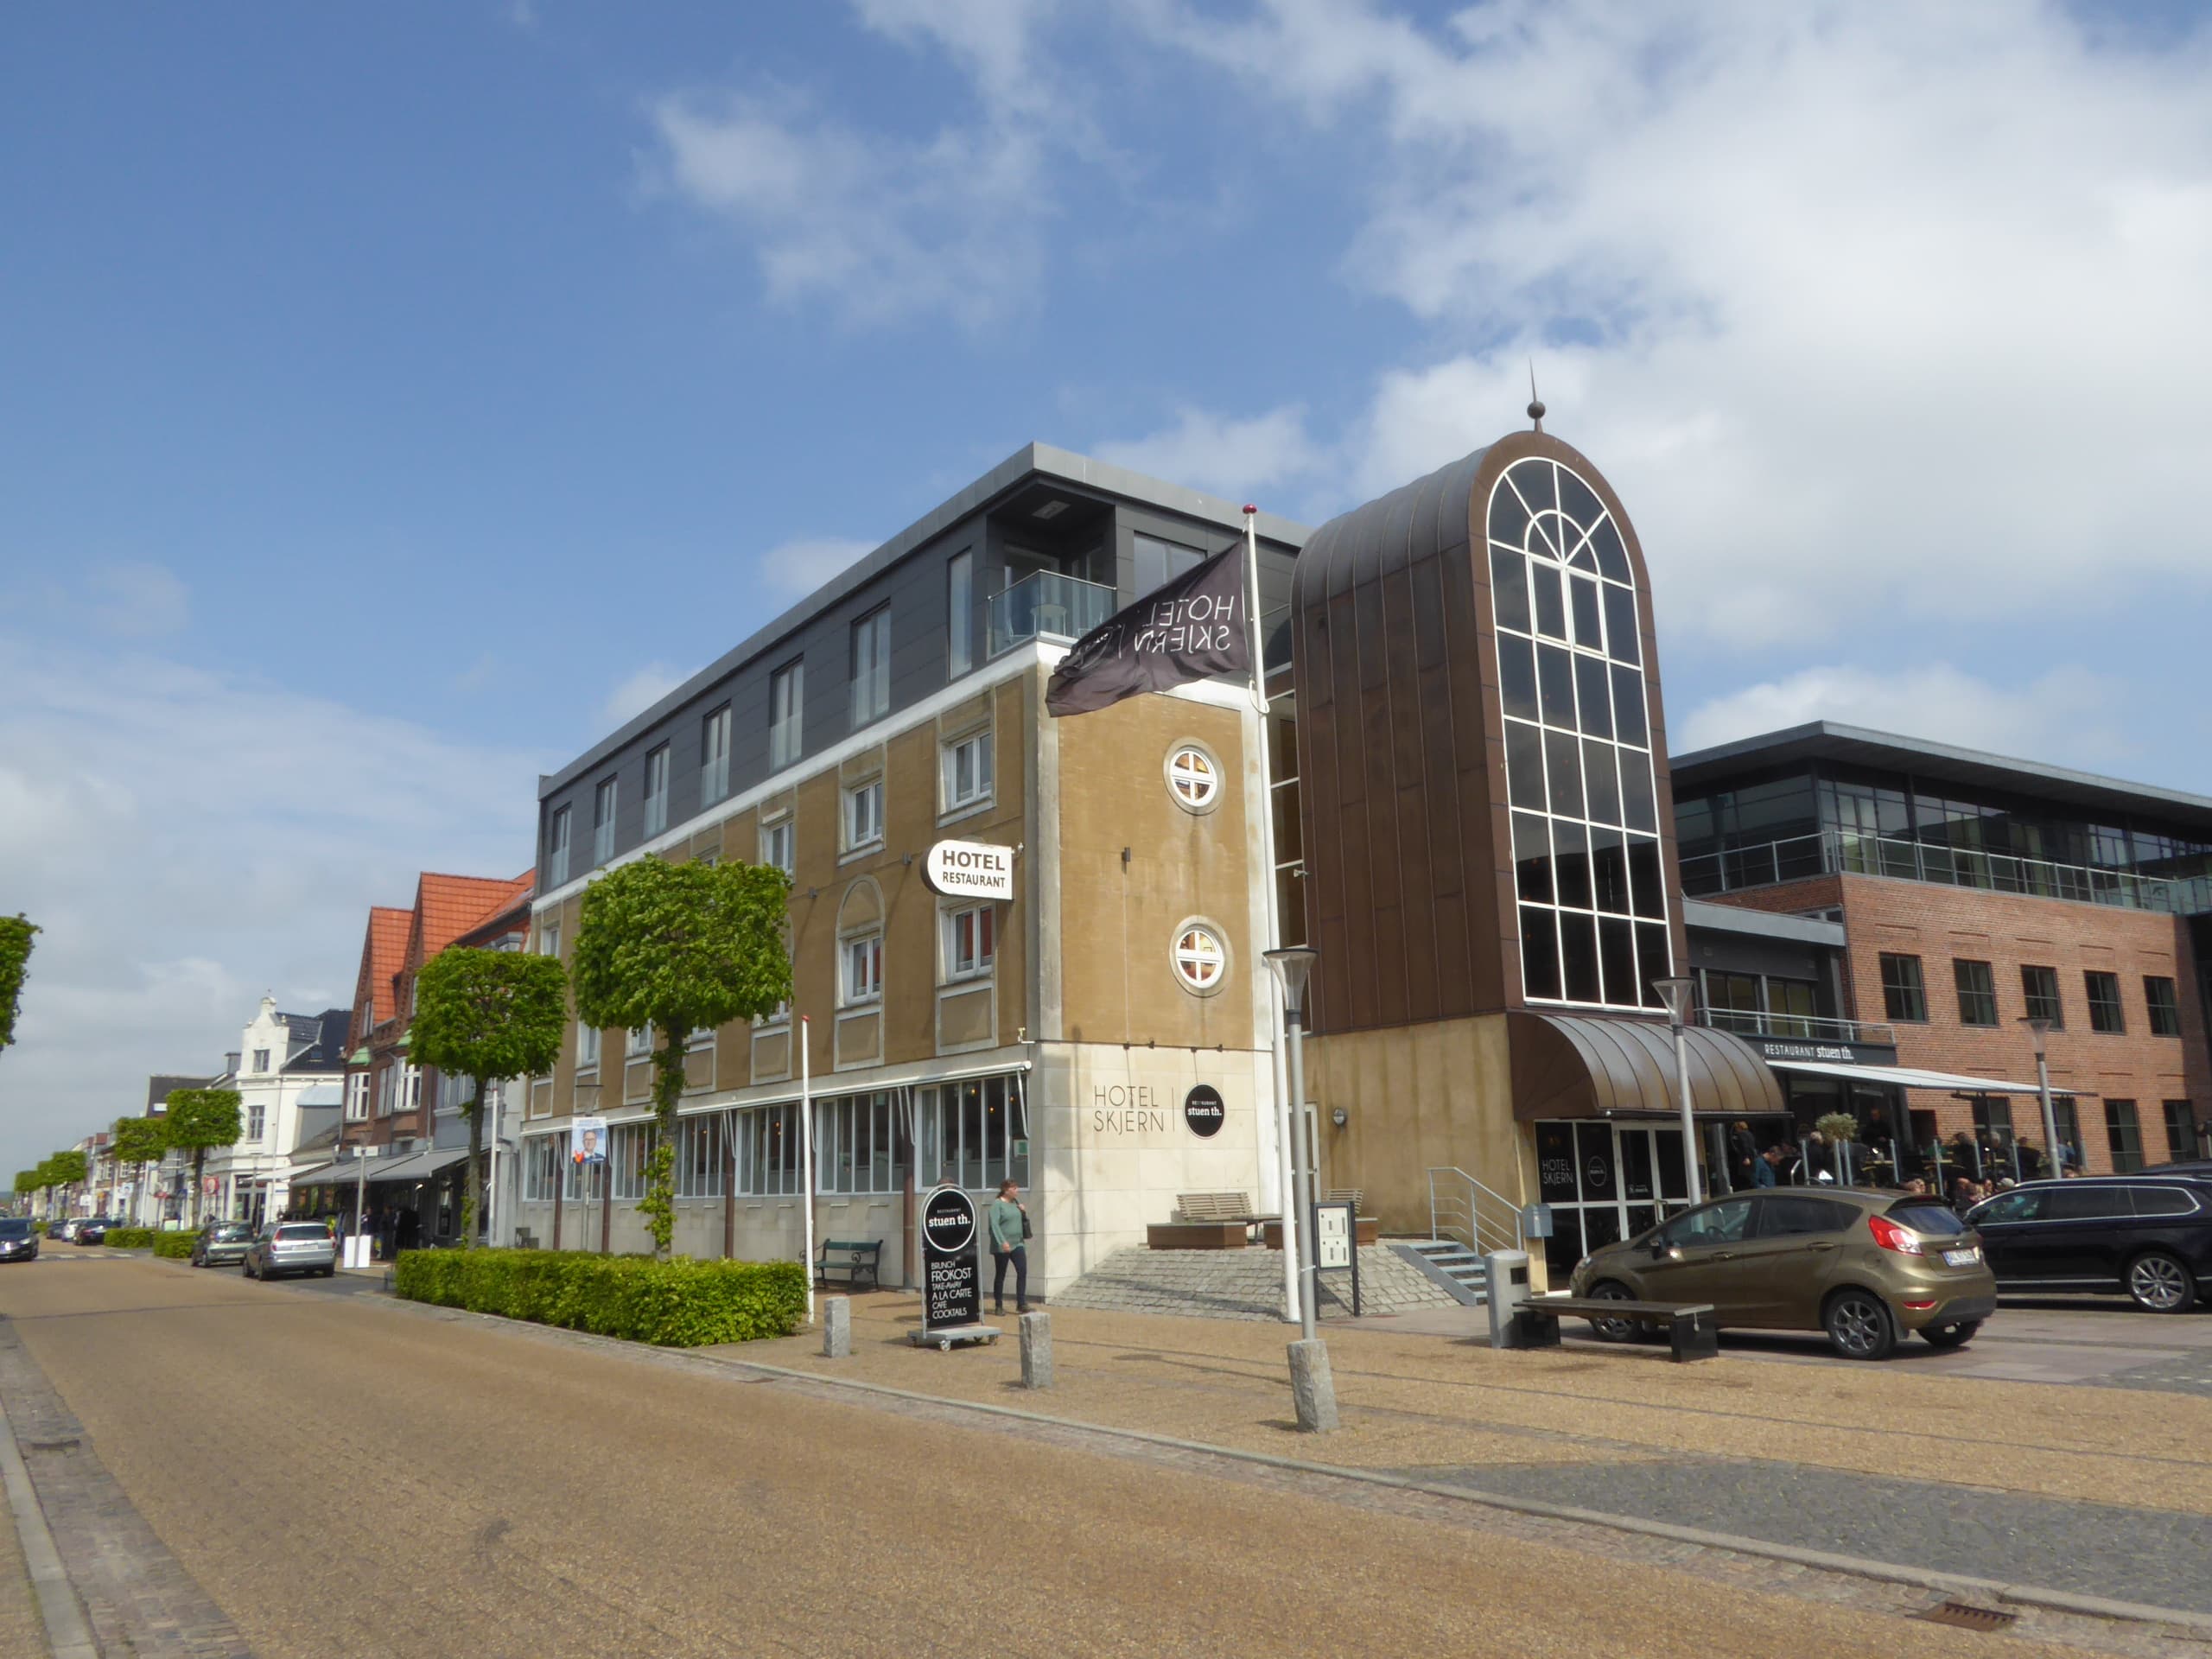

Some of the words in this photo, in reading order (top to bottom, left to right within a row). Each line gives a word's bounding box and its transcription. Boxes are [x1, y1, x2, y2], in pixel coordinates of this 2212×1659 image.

[943, 850, 1005, 871] HOTEL
[942, 871, 1005, 888] RESTAURANT
[1764, 1044, 1815, 1057] RESTAURANT
[1816, 1046, 1841, 1059] stuen
[1841, 1046, 1854, 1059] th.
[1094, 1085, 1159, 1108] HOTEL
[1187, 1107, 1210, 1116] stuen
[1211, 1106, 1223, 1116] th.
[1093, 1110, 1165, 1135] SKJERN
[1541, 1159, 1571, 1172] HOTEL
[1542, 1171, 1573, 1185] SKJERN
[929, 1217, 956, 1227] stuen
[957, 1213, 971, 1225] th.
[931, 1260, 956, 1270] BRUNCH
[931, 1268, 971, 1281] FROKOST
[938, 1290, 949, 1300] LA
[950, 1287, 972, 1299] CARTE
[931, 1306, 968, 1319] COCKTAILS
